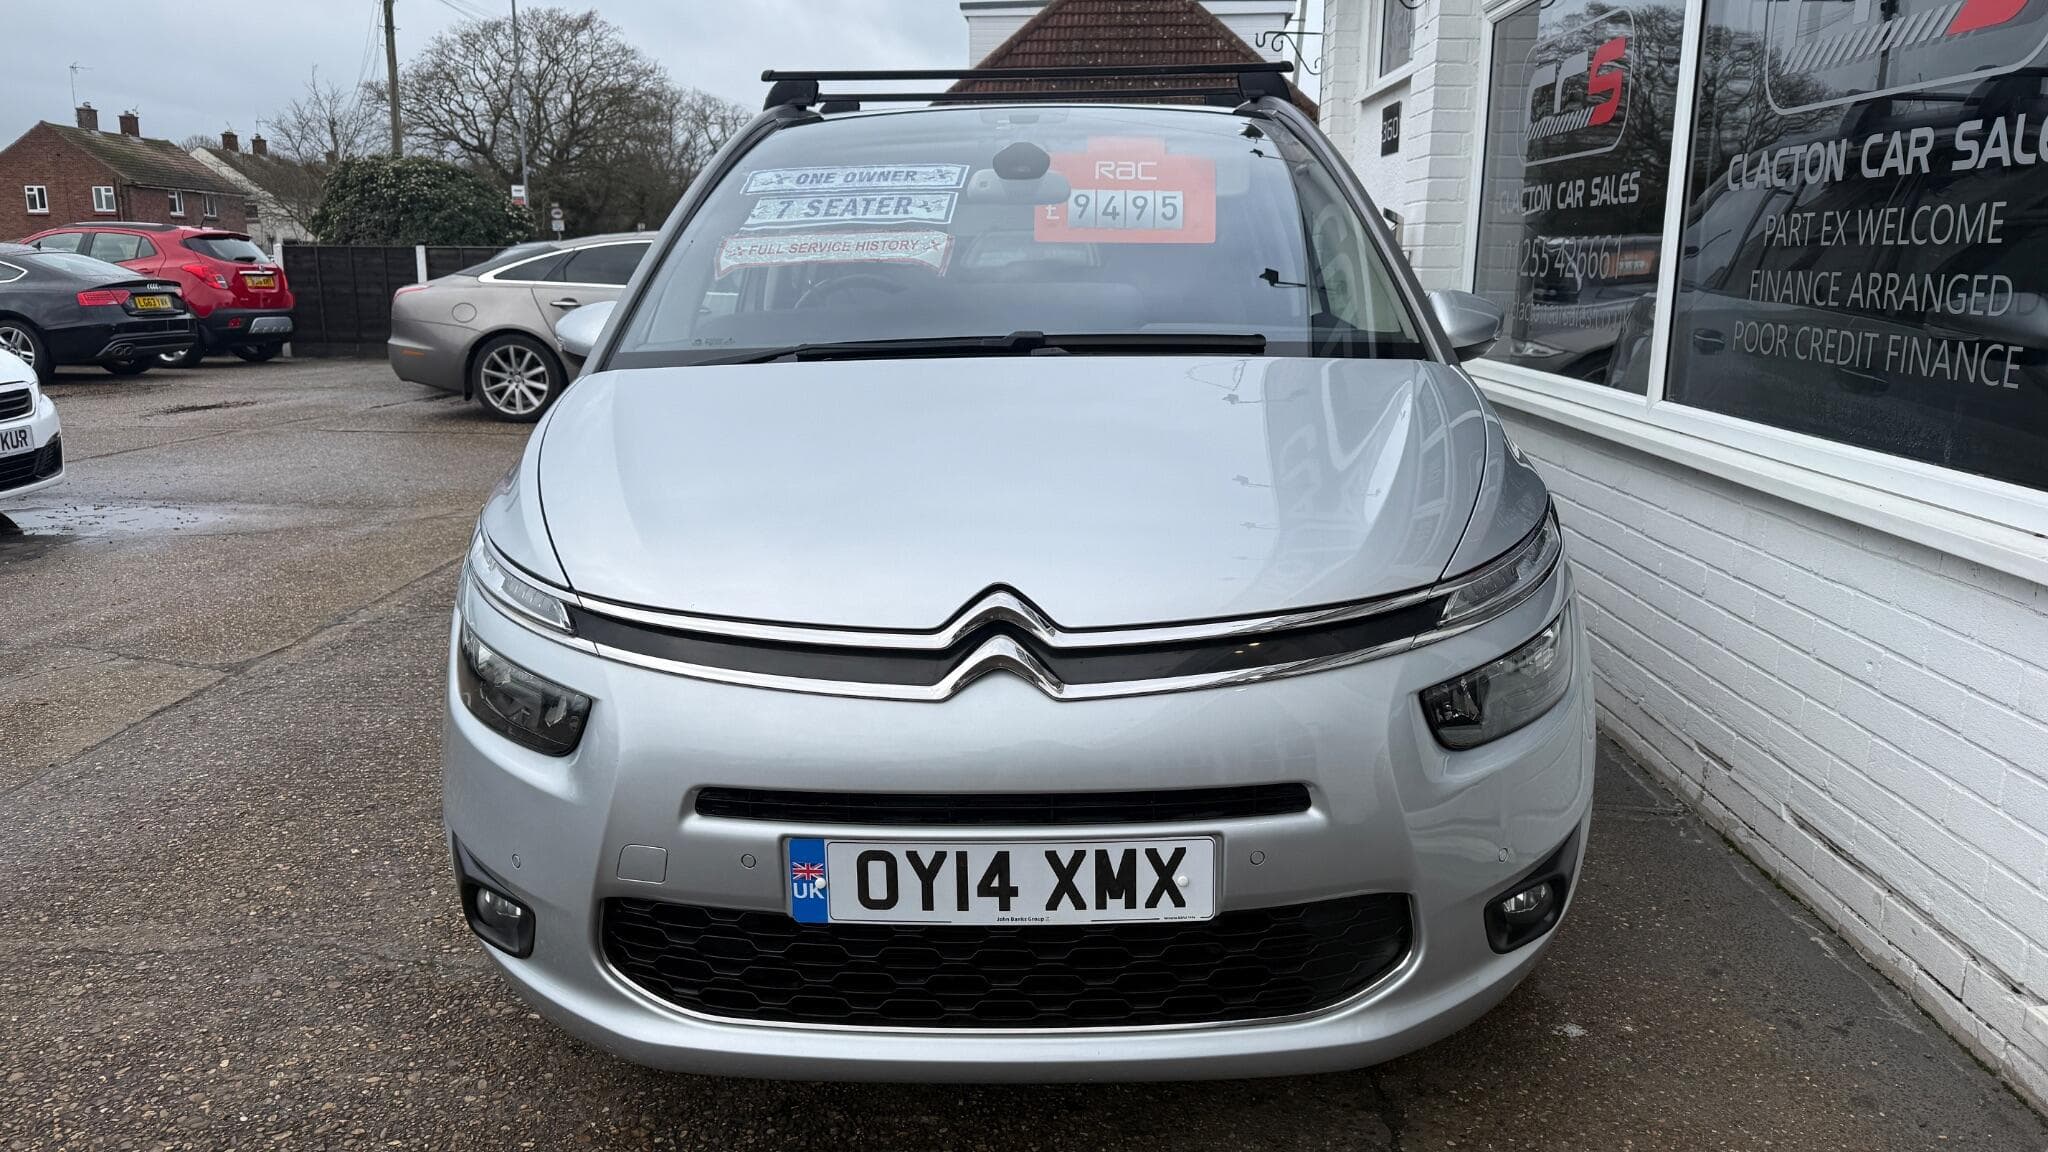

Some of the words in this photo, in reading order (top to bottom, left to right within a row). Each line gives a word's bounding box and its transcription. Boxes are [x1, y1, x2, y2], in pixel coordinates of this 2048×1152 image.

[1382, 116, 1399, 144] 360
[1727, 138, 1848, 192] CLACTON
[1860, 126, 1935, 179] CAR
[1951, 112, 2048, 171] SAL
[795, 172, 836, 185] ONE
[843, 170, 918, 184] OWNER
[1500, 183, 1553, 214] CLACTON
[1556, 179, 1585, 210] CAR
[1589, 170, 1641, 207] SALES
[776, 200, 794, 219] 7
[804, 196, 914, 218] SEATER
[1073, 193, 1178, 222] 9495
[1763, 211, 1816, 247] PART
[1820, 210, 1850, 247] EX
[1857, 201, 2008, 247] WELCOME
[747, 244, 784, 256] FULL
[788, 241, 854, 255] SERVICE
[855, 239, 920, 252] HISTORY
[1554, 234, 1623, 280] 426661
[1749, 269, 1842, 307] FINANCE
[1846, 272, 2014, 317] ARRANGED
[1732, 320, 1788, 358] POOR
[1794, 326, 1880, 369] CREDIT
[1885, 333, 2024, 390] FINANCE
[0, 429, 28, 451] KUR
[793, 882, 825, 899] UK
[856, 849, 1019, 912] OY14
[1044, 847, 1187, 911] XMX
